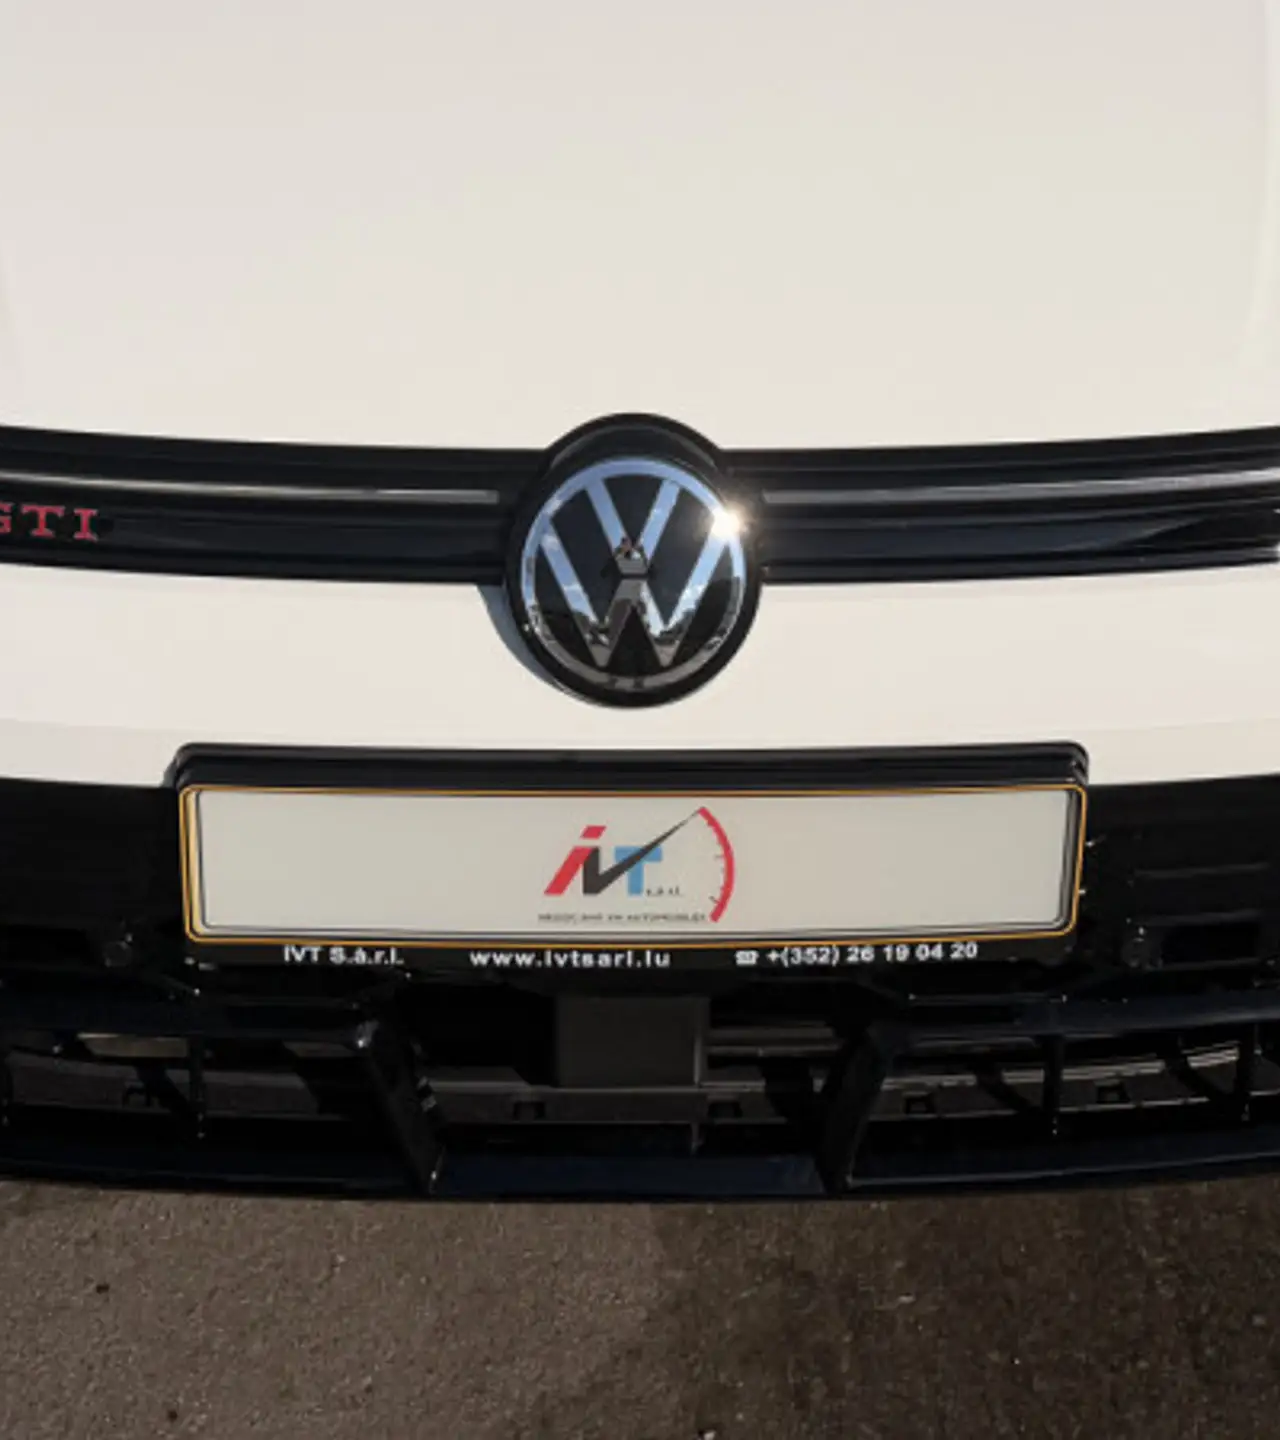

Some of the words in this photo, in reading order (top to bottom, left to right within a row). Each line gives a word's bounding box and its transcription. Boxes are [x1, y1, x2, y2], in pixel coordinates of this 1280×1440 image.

[283, 944, 322, 963] IVT
[766, 944, 840, 968] +(352)
[847, 944, 874, 963] 26
[883, 943, 909, 962] 19
[915, 942, 943, 961] 04
[949, 940, 979, 960] 20
